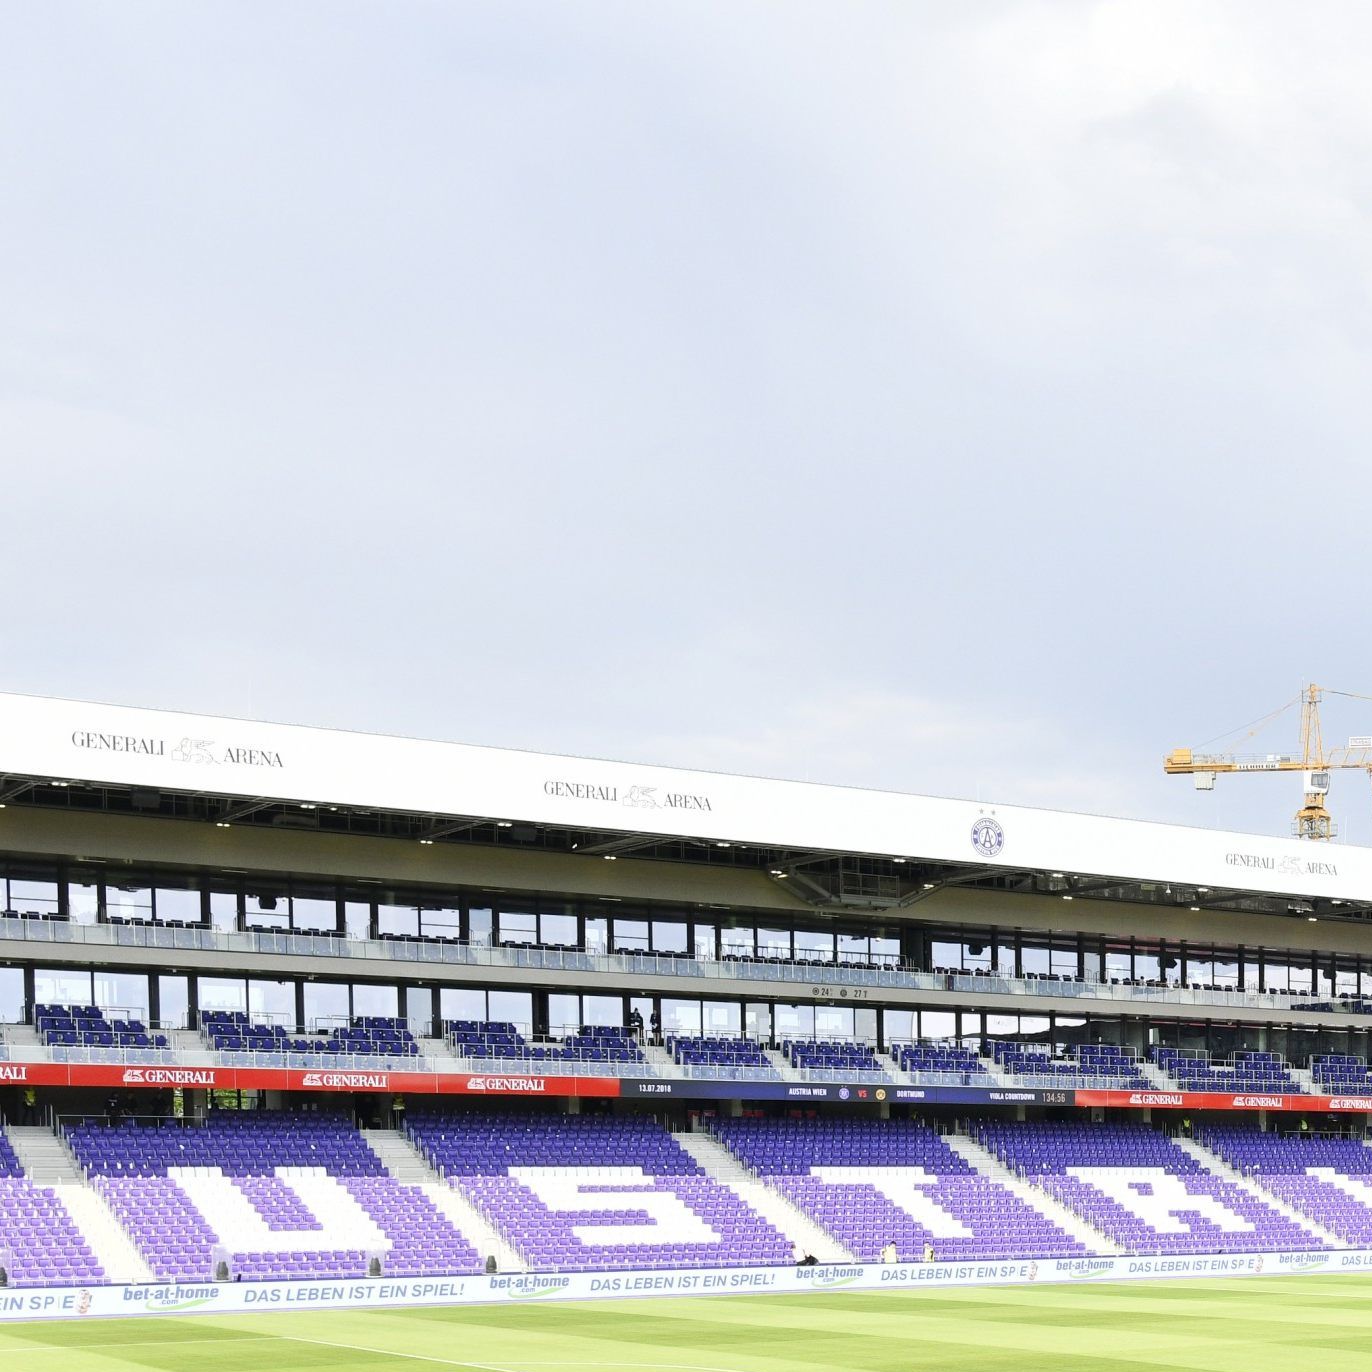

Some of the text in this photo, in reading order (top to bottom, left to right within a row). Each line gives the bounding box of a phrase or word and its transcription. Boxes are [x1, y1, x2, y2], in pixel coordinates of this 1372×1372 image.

[72, 731, 283, 768] GENERALI ARENA
[544, 781, 712, 811] GENERALI ARENA
[1226, 853, 1338, 876] GENERALI ARENA
[145, 1069, 215, 1083] GENERALI
[323, 1074, 387, 1088] GENERALI
[486, 1078, 545, 1091] GENERALI
[639, 1084, 671, 1093] 13.07.2018
[789, 1087, 827, 1096] AUSTRIA WIEN
[858, 1090, 867, 1098] VS
[896, 1090, 924, 1098] DORTMUND
[1143, 1094, 1183, 1104] GENERALI
[1245, 1097, 1283, 1107] GENERALI
[1056, 1259, 1114, 1271] bet-at-home
[1279, 1253, 1330, 1264] bet-at-home
[1341, 1256, 1362, 1266] DAS
[796, 1266, 864, 1279] bet-at-home
[1128, 1262, 1152, 1273] DAS
[1154, 1261, 1190, 1272] LEBEN
[1192, 1260, 1209, 1271] IST
[1211, 1259, 1229, 1270] EIN
[881, 1269, 907, 1281] DAS
[910, 1267, 952, 1280] LEBEN
[955, 1266, 975, 1279] IST
[976, 1266, 998, 1278] EIN
[490, 1276, 570, 1289] bet-at-home
[590, 1273, 775, 1291] DAS LEBEN IST EIN SPIEL!
[124, 1286, 219, 1301] bet-at-home
[244, 1283, 465, 1303] DAS LEBEN IST EIN SPIEL!
[0, 1297, 24, 1311] IN
